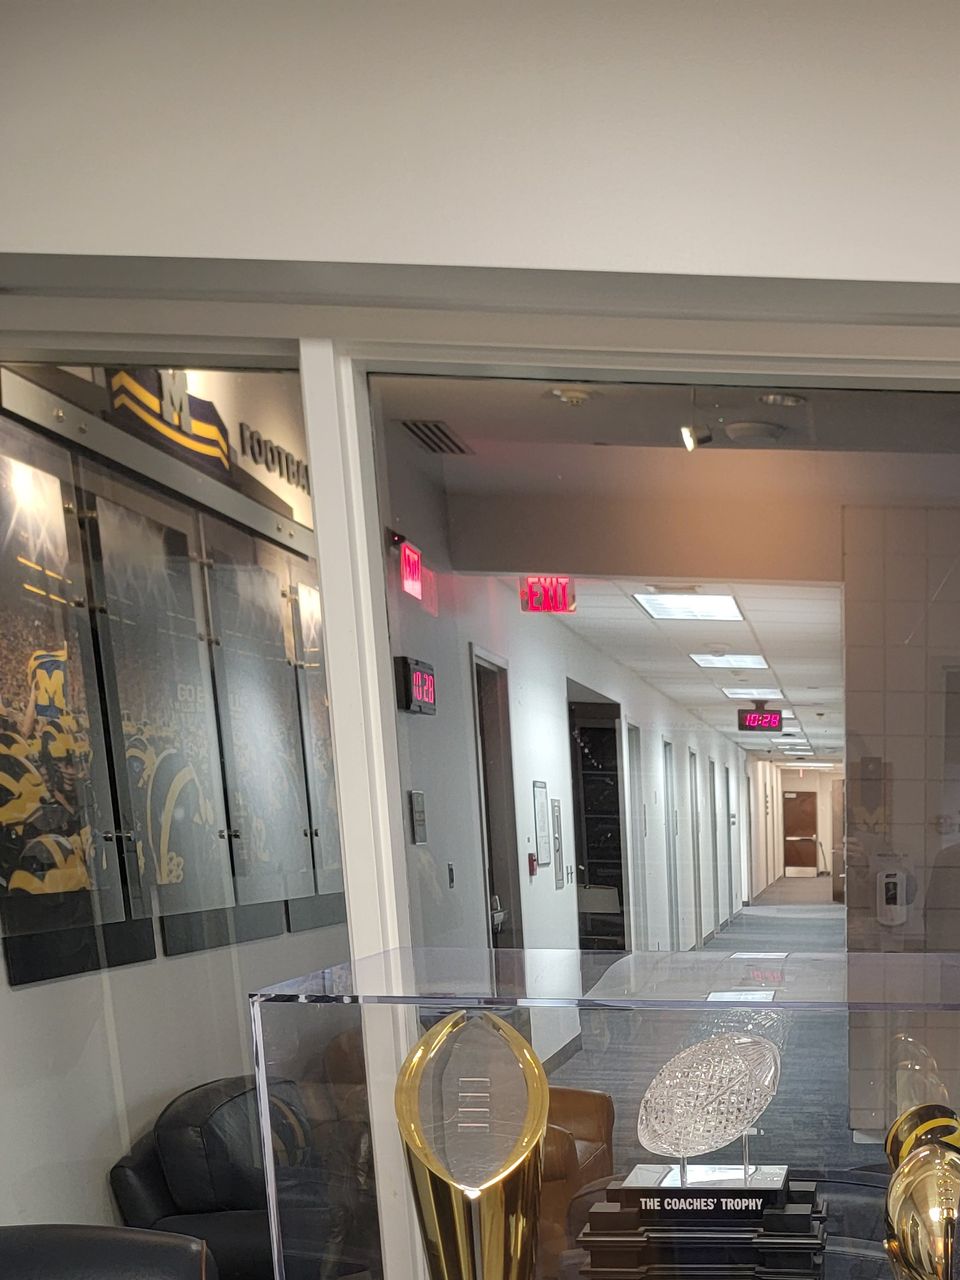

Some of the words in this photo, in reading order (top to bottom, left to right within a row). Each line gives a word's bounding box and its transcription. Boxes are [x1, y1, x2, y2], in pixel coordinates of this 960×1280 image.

[239, 422, 311, 496] FOOTBA
[527, 576, 569, 611] EXIT
[36, 669, 66, 708] M
[746, 713, 779, 727] 10:28
[640, 1198, 661, 1210] THE
[664, 1198, 717, 1210] COACHES'
[720, 1198, 763, 1210] TROPHY
